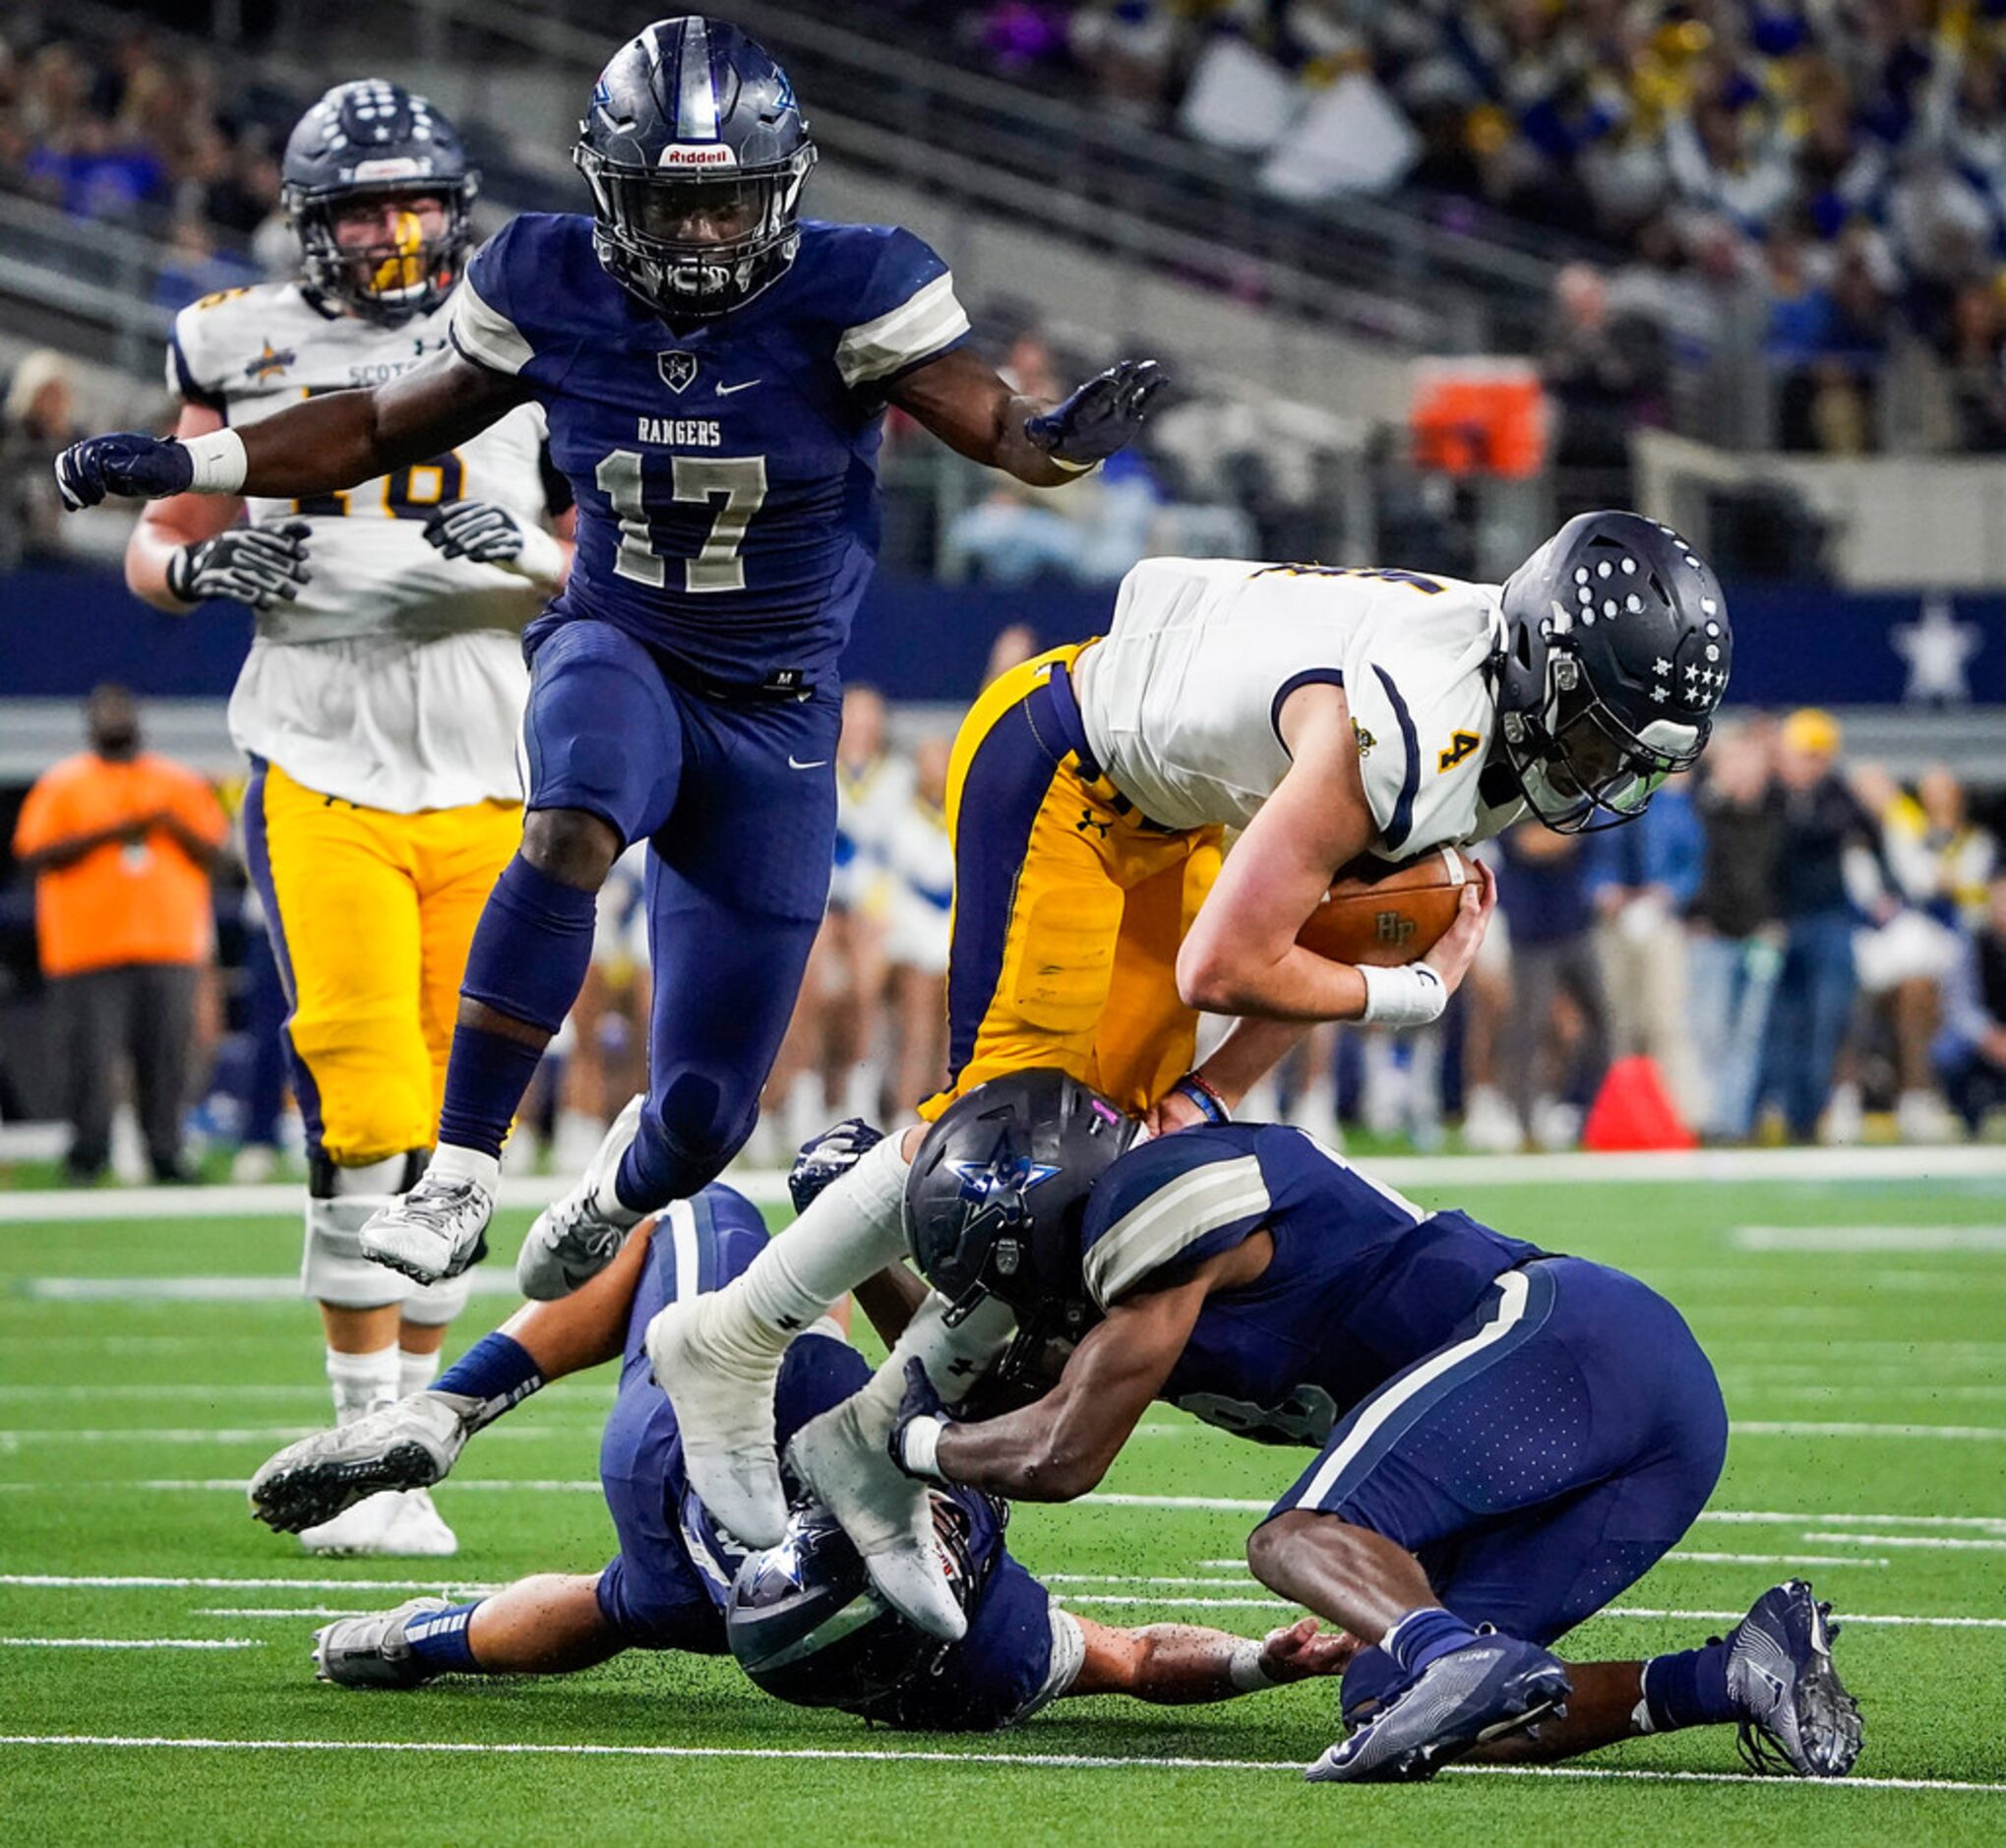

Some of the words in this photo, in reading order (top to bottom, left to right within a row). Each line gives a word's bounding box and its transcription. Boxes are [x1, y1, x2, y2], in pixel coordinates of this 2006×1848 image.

[669, 151, 726, 163] Riddell
[638, 416, 722, 448] RANGERS
[595, 449, 768, 592] 17
[1437, 729, 1481, 774] 4
